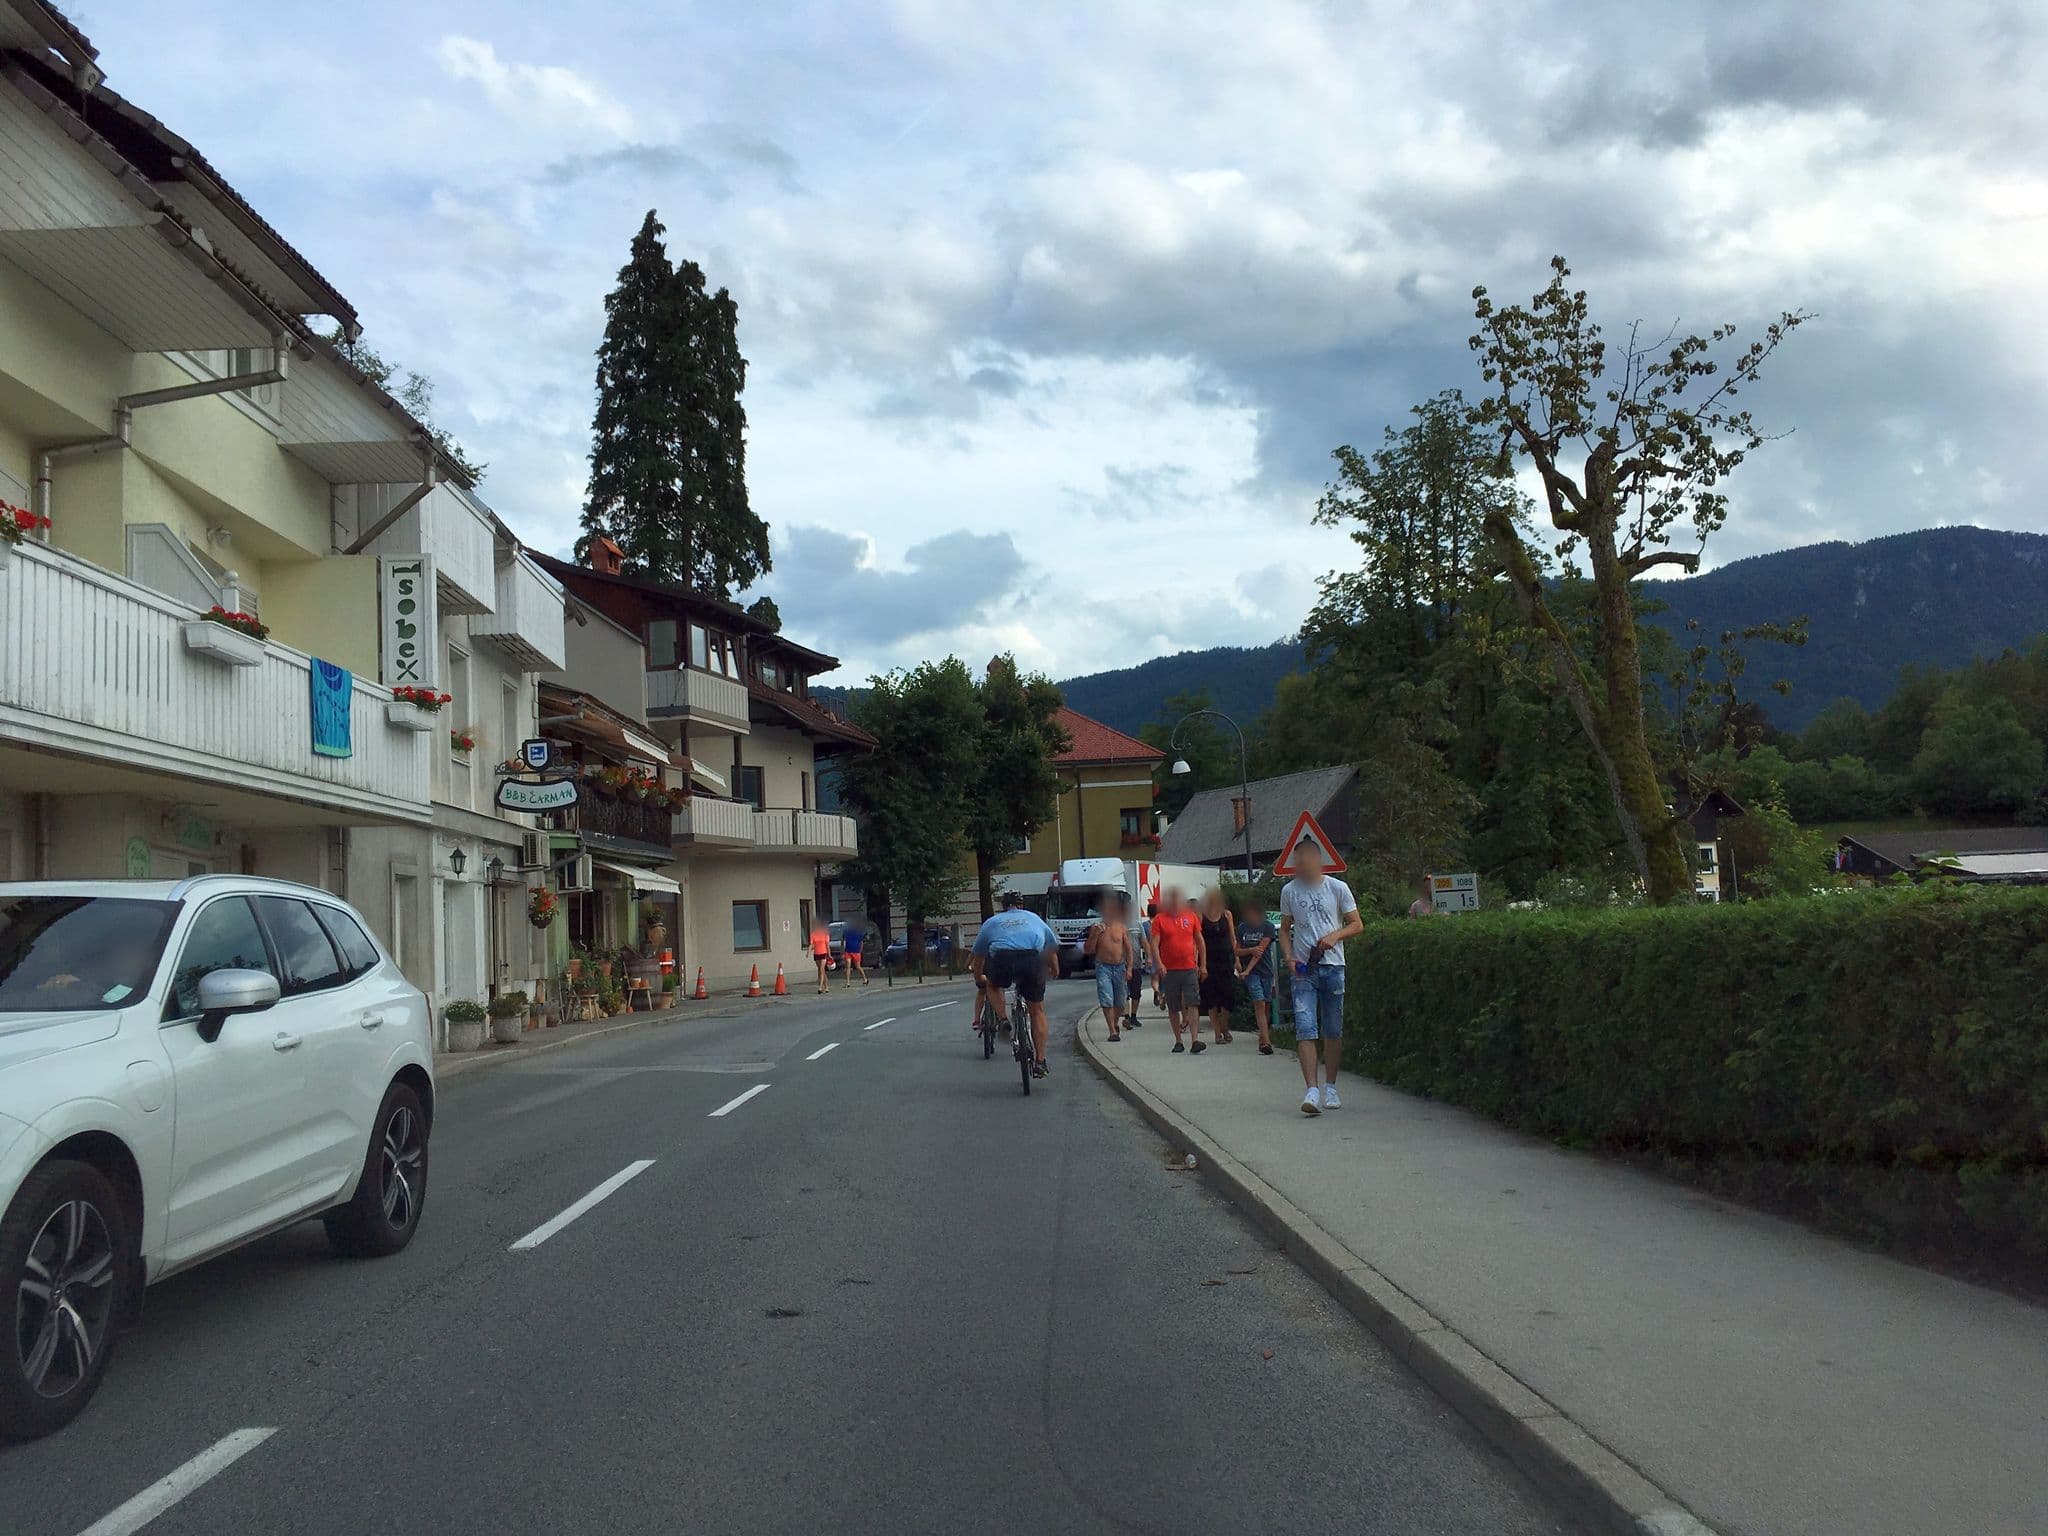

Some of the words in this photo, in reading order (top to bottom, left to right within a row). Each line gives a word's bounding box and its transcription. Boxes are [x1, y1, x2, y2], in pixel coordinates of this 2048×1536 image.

[395, 578, 417, 659] sobe
[505, 788, 527, 803] B&B
[1436, 900, 1448, 908] km
